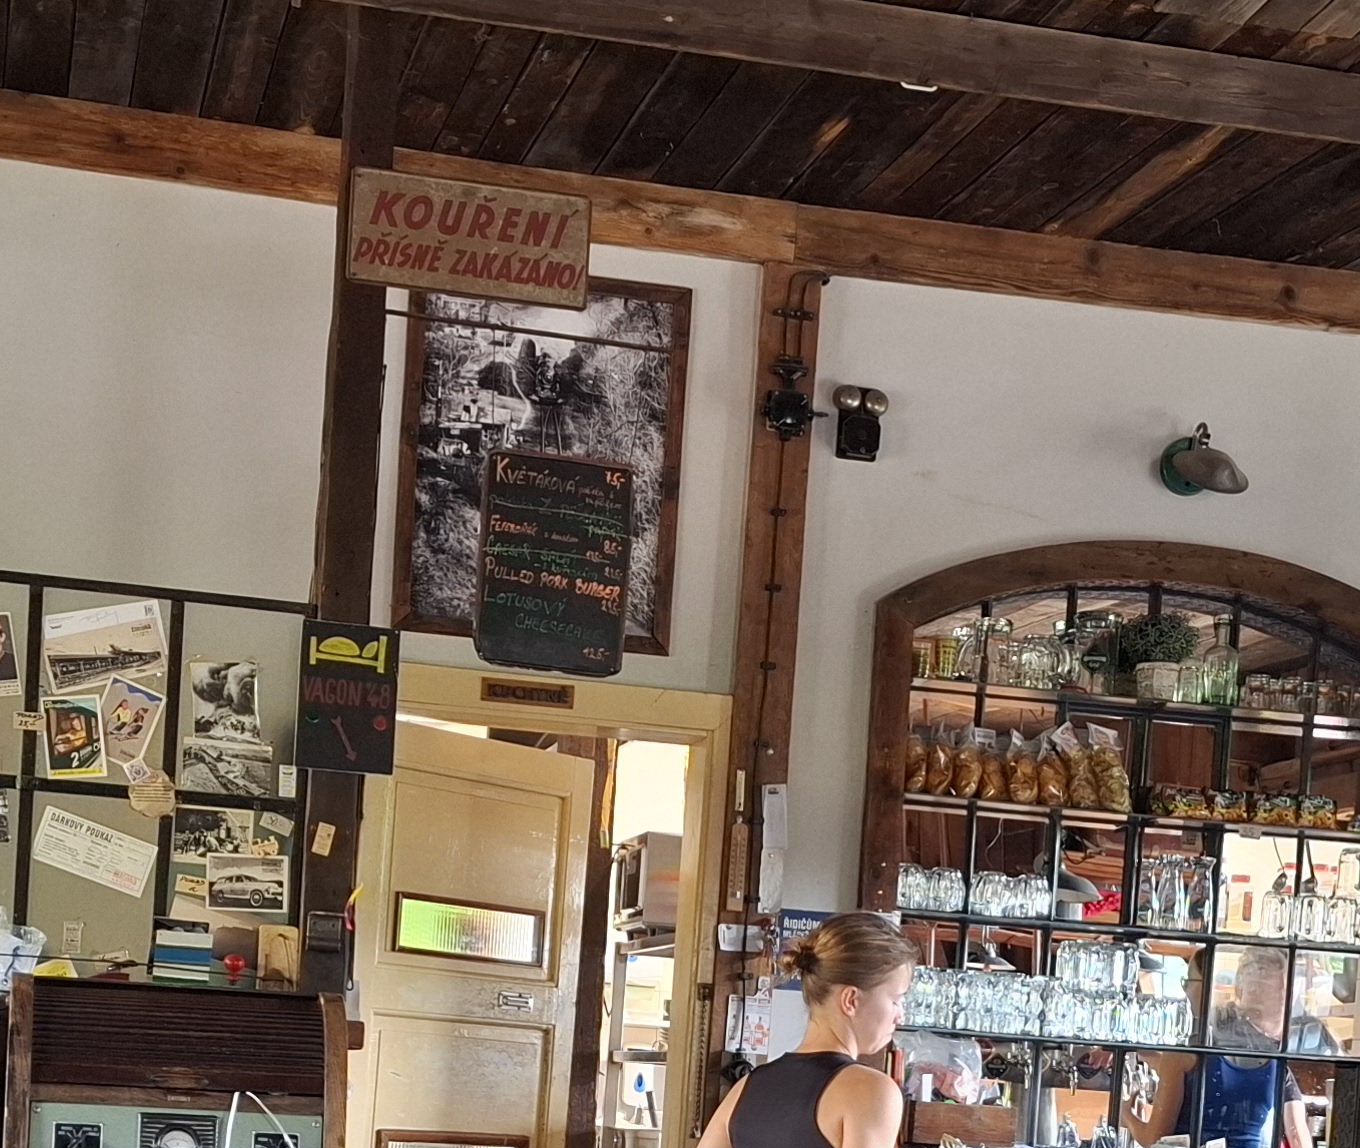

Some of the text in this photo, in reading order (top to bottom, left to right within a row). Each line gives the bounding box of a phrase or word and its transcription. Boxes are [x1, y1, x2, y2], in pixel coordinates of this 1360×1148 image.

[369, 189, 579, 249] KOUŘENÍ
[352, 231, 584, 290] PŘÍSNĚ ZAKÁZÁNO!
[303, 675, 362, 707] VAGON
